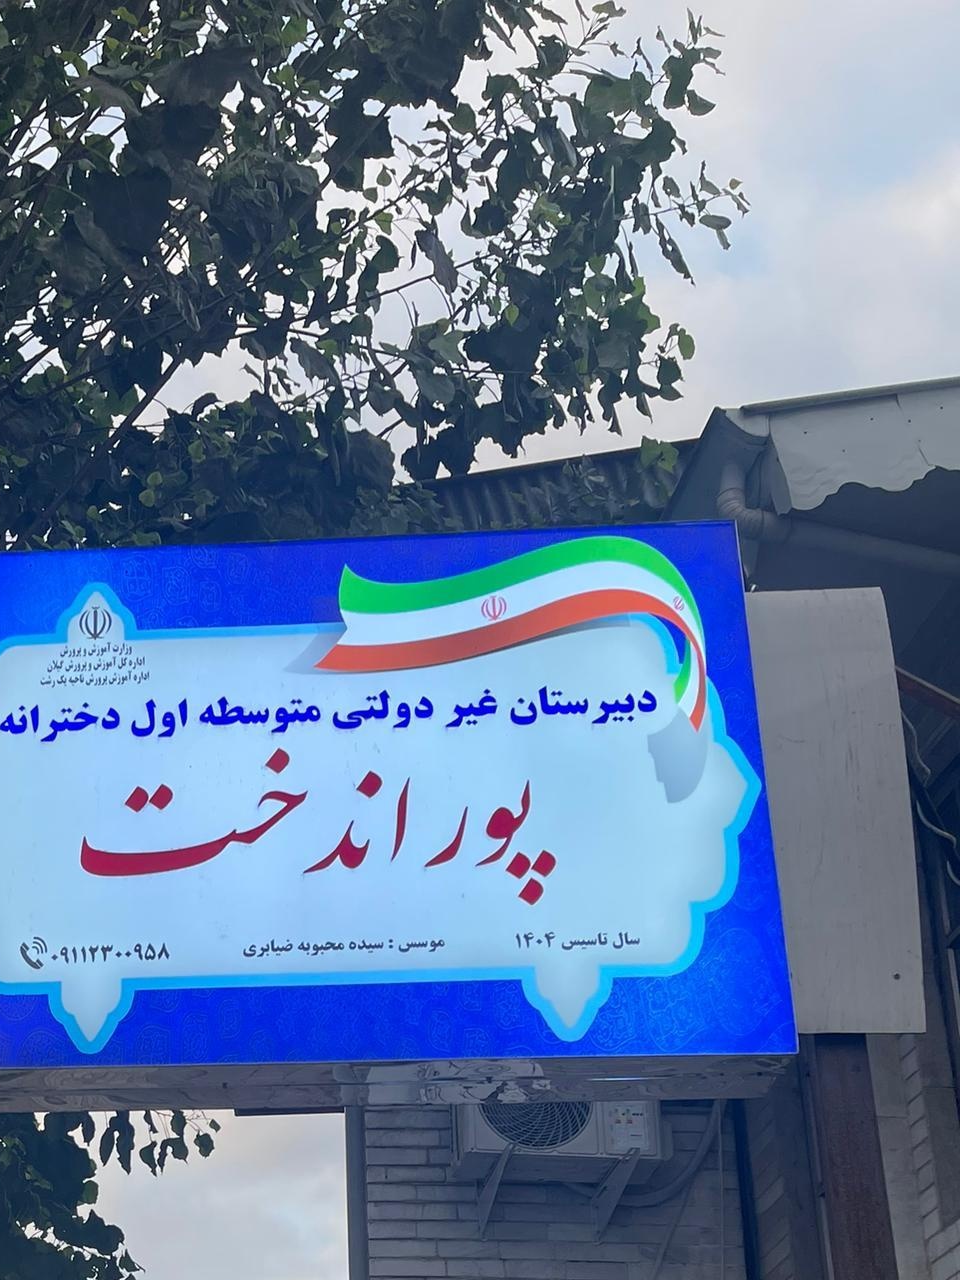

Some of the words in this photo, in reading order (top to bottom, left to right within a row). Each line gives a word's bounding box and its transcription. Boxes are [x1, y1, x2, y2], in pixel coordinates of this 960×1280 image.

[60, 645, 82, 657] پرورش
[88, 641, 111, 657] آموزش
[112, 643, 133, 656] وزارت
[47, 659, 64, 673] گیلان
[65, 660, 87, 672] پرورش
[93, 656, 116, 671] آموزش
[117, 657, 127, 669] کل
[128, 656, 145, 670] اداره
[40, 675, 55, 688] رشت
[56, 675, 67, 687] یک
[68, 675, 84, 686] ناحیه
[85, 674, 108, 686] پرورش
[108, 671, 131, 685] آموزش
[133, 671, 150, 685] اداره
[332, 689, 434, 729] دولتی
[445, 689, 498, 728] غیر
[510, 686, 657, 726] دبیرستان
[0, 702, 121, 742] دخترانه
[131, 698, 188, 738] اول
[199, 696, 321, 733] متوسطه
[349, 938, 384, 953] سیده
[398, 938, 445, 953] موسس
[515, 931, 556, 949] ۱۴۰۴
[561, 932, 608, 950] تاسیس
[612, 931, 640, 949] سال
[51, 942, 170, 964] ۰۹۱۱۲۳۰۰۹۵۸
[243, 938, 293, 958] ضیابری
[297, 940, 345, 956] محبوبه
